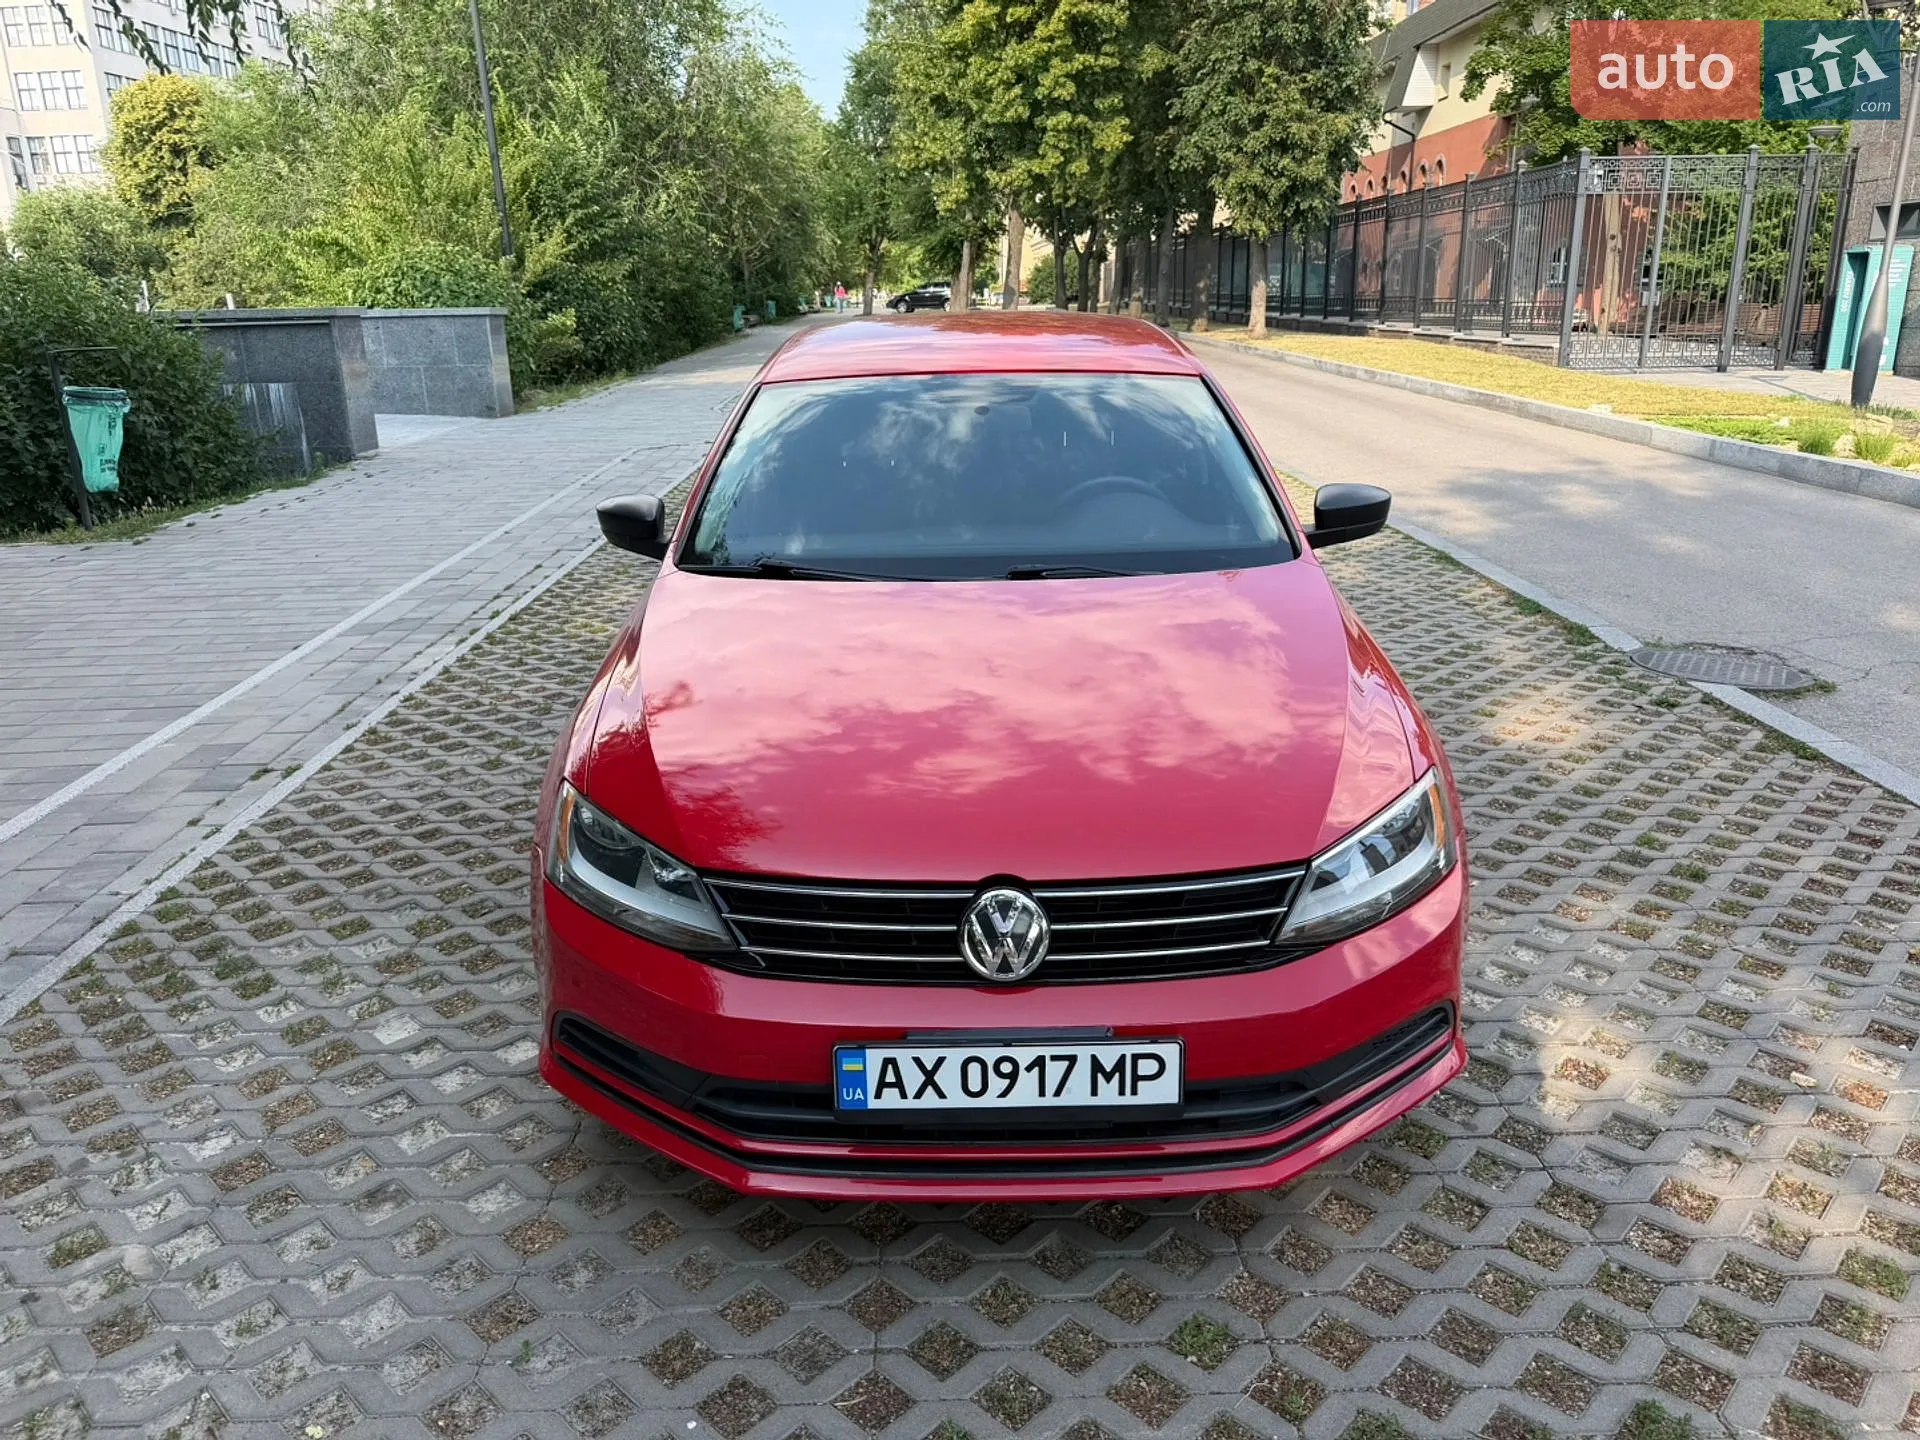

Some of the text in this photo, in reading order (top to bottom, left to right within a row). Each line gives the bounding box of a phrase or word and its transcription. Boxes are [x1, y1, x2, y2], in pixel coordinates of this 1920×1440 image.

[874, 1052, 1167, 1100] AX 0917 MP
[842, 1087, 865, 1101] UA
